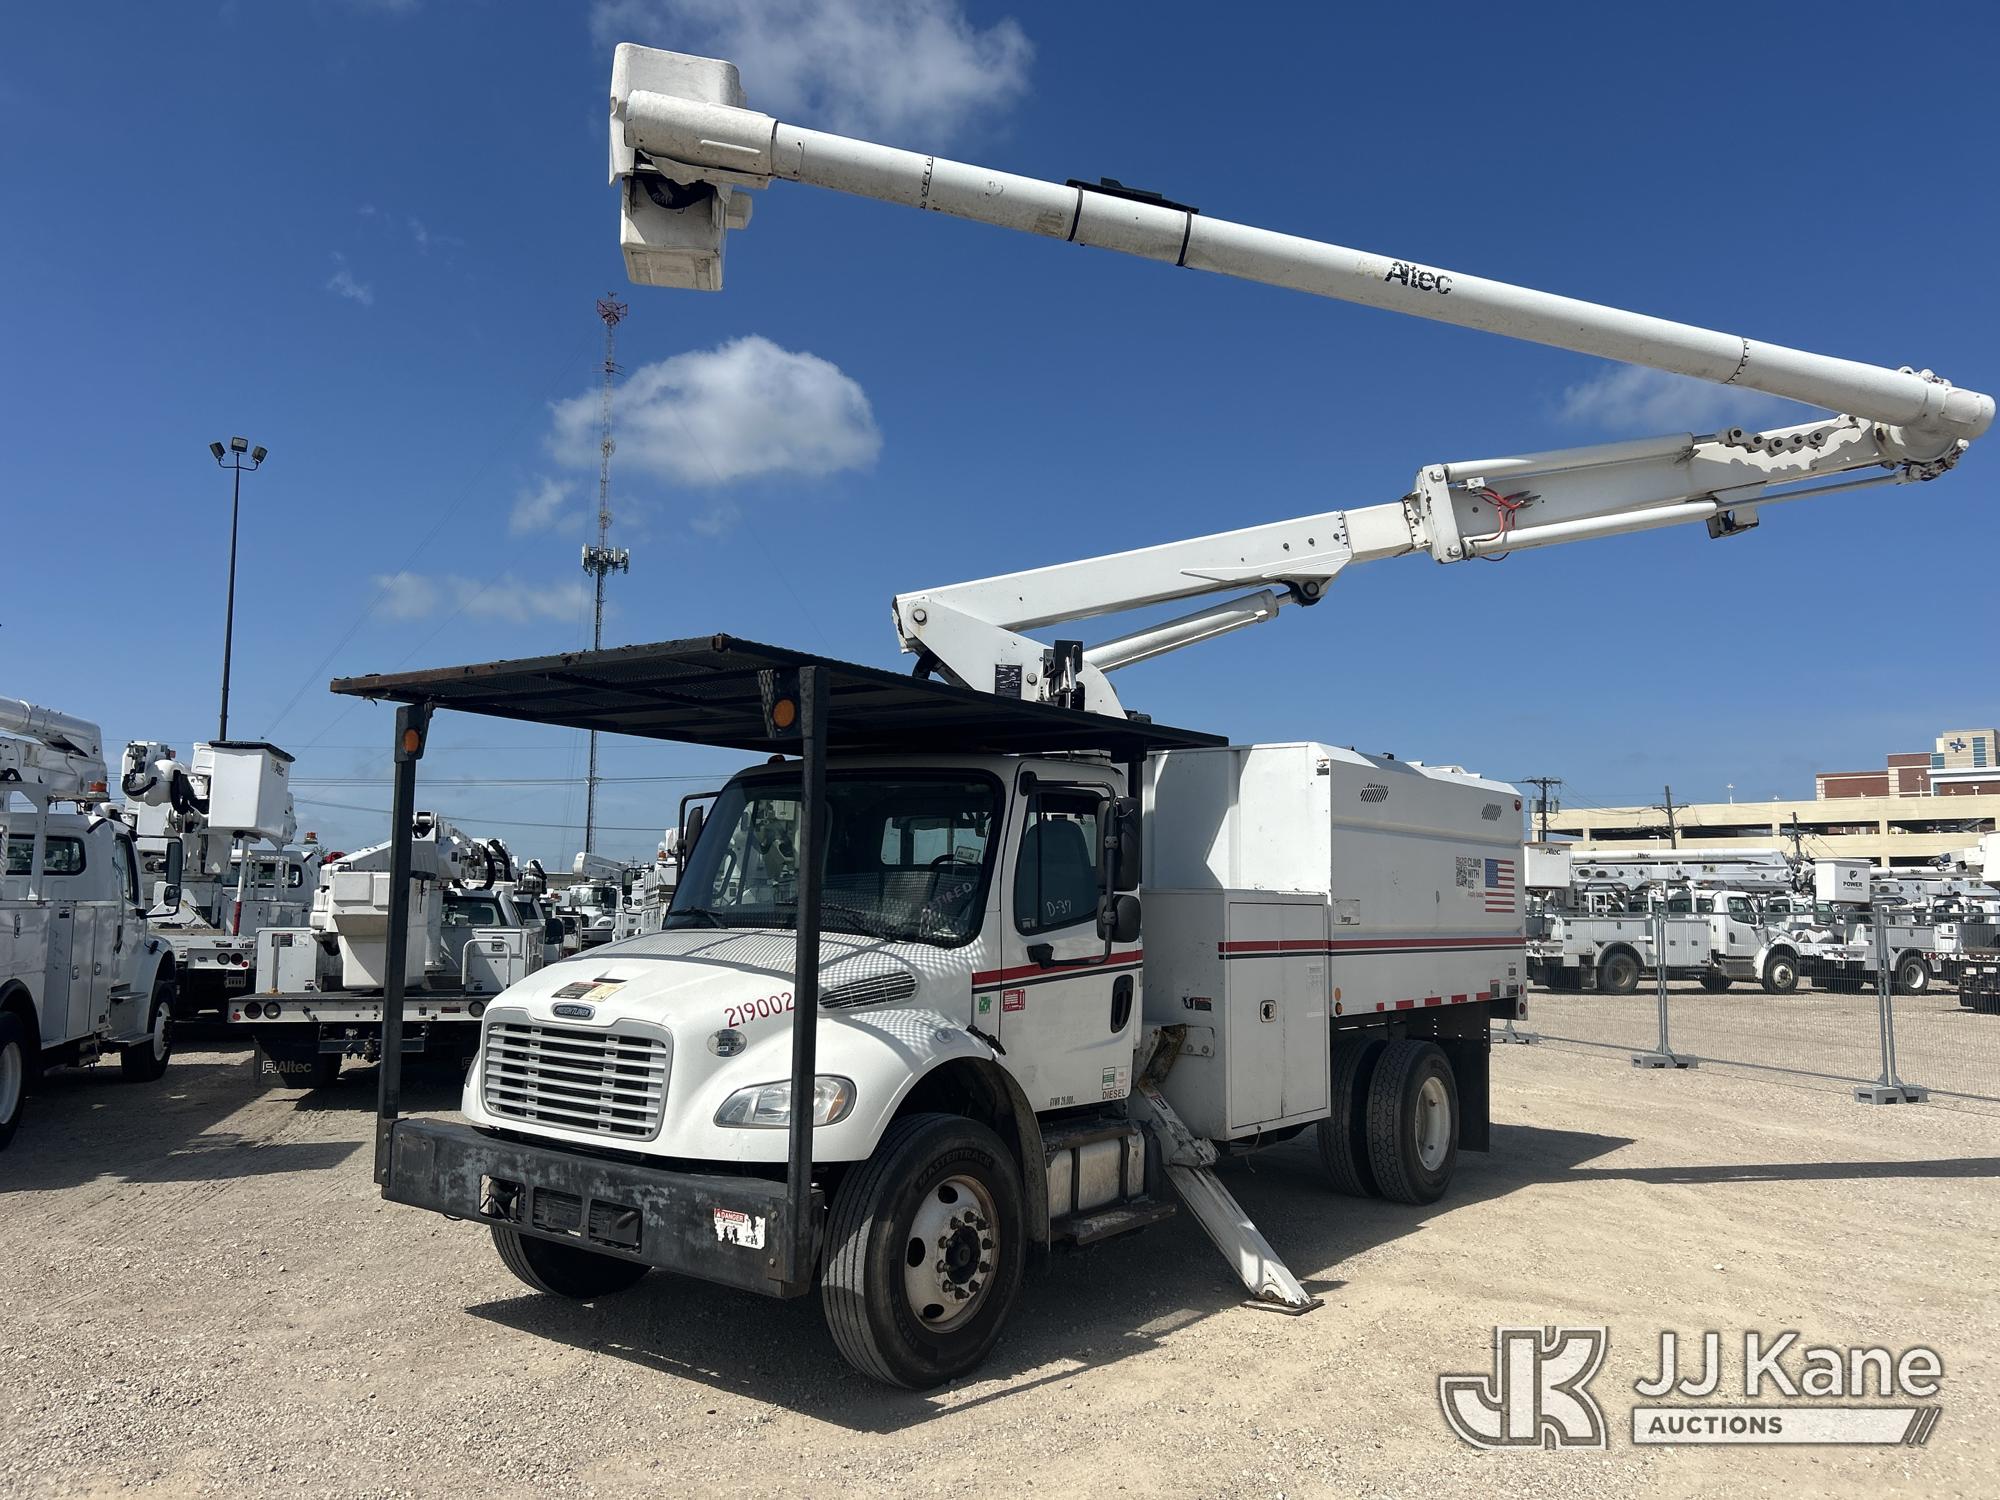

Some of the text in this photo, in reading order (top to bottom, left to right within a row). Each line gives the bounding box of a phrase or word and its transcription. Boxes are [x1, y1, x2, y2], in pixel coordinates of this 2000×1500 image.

[1384, 261, 1453, 295] Altec
[1467, 857, 1482, 869] CLIMB
[1467, 869, 1480, 879] WITH
[1467, 879, 1475, 890] US
[724, 992, 795, 1028] 219002
[278, 1060, 312, 1073] Altec
[1102, 1088, 1126, 1100] DIESEL
